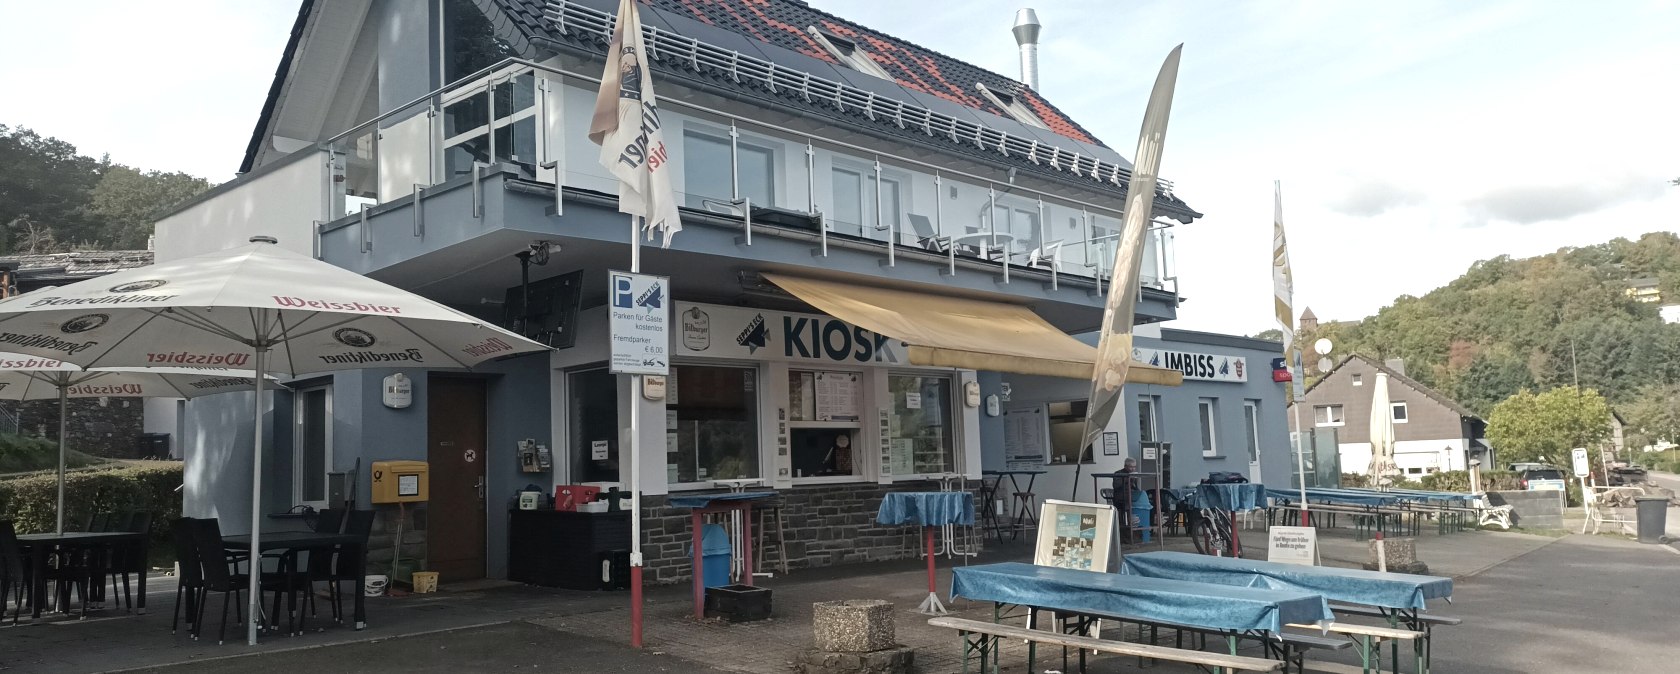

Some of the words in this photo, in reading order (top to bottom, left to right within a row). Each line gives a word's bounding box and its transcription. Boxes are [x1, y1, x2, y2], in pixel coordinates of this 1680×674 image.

[615, 276, 632, 305] P
[25, 294, 180, 309] Benediktiner
[272, 295, 401, 314] Weissbier
[613, 312, 634, 320] Parken
[636, 313, 644, 321] für
[645, 315, 663, 323] Gäste
[635, 324, 663, 332] kostenlos
[736, 322, 754, 345] SEPPI'S
[753, 312, 764, 326] ECK
[613, 334, 651, 344] Fremdparker
[783, 315, 898, 363] KIOSK
[1165, 351, 1215, 378] IMBISS
